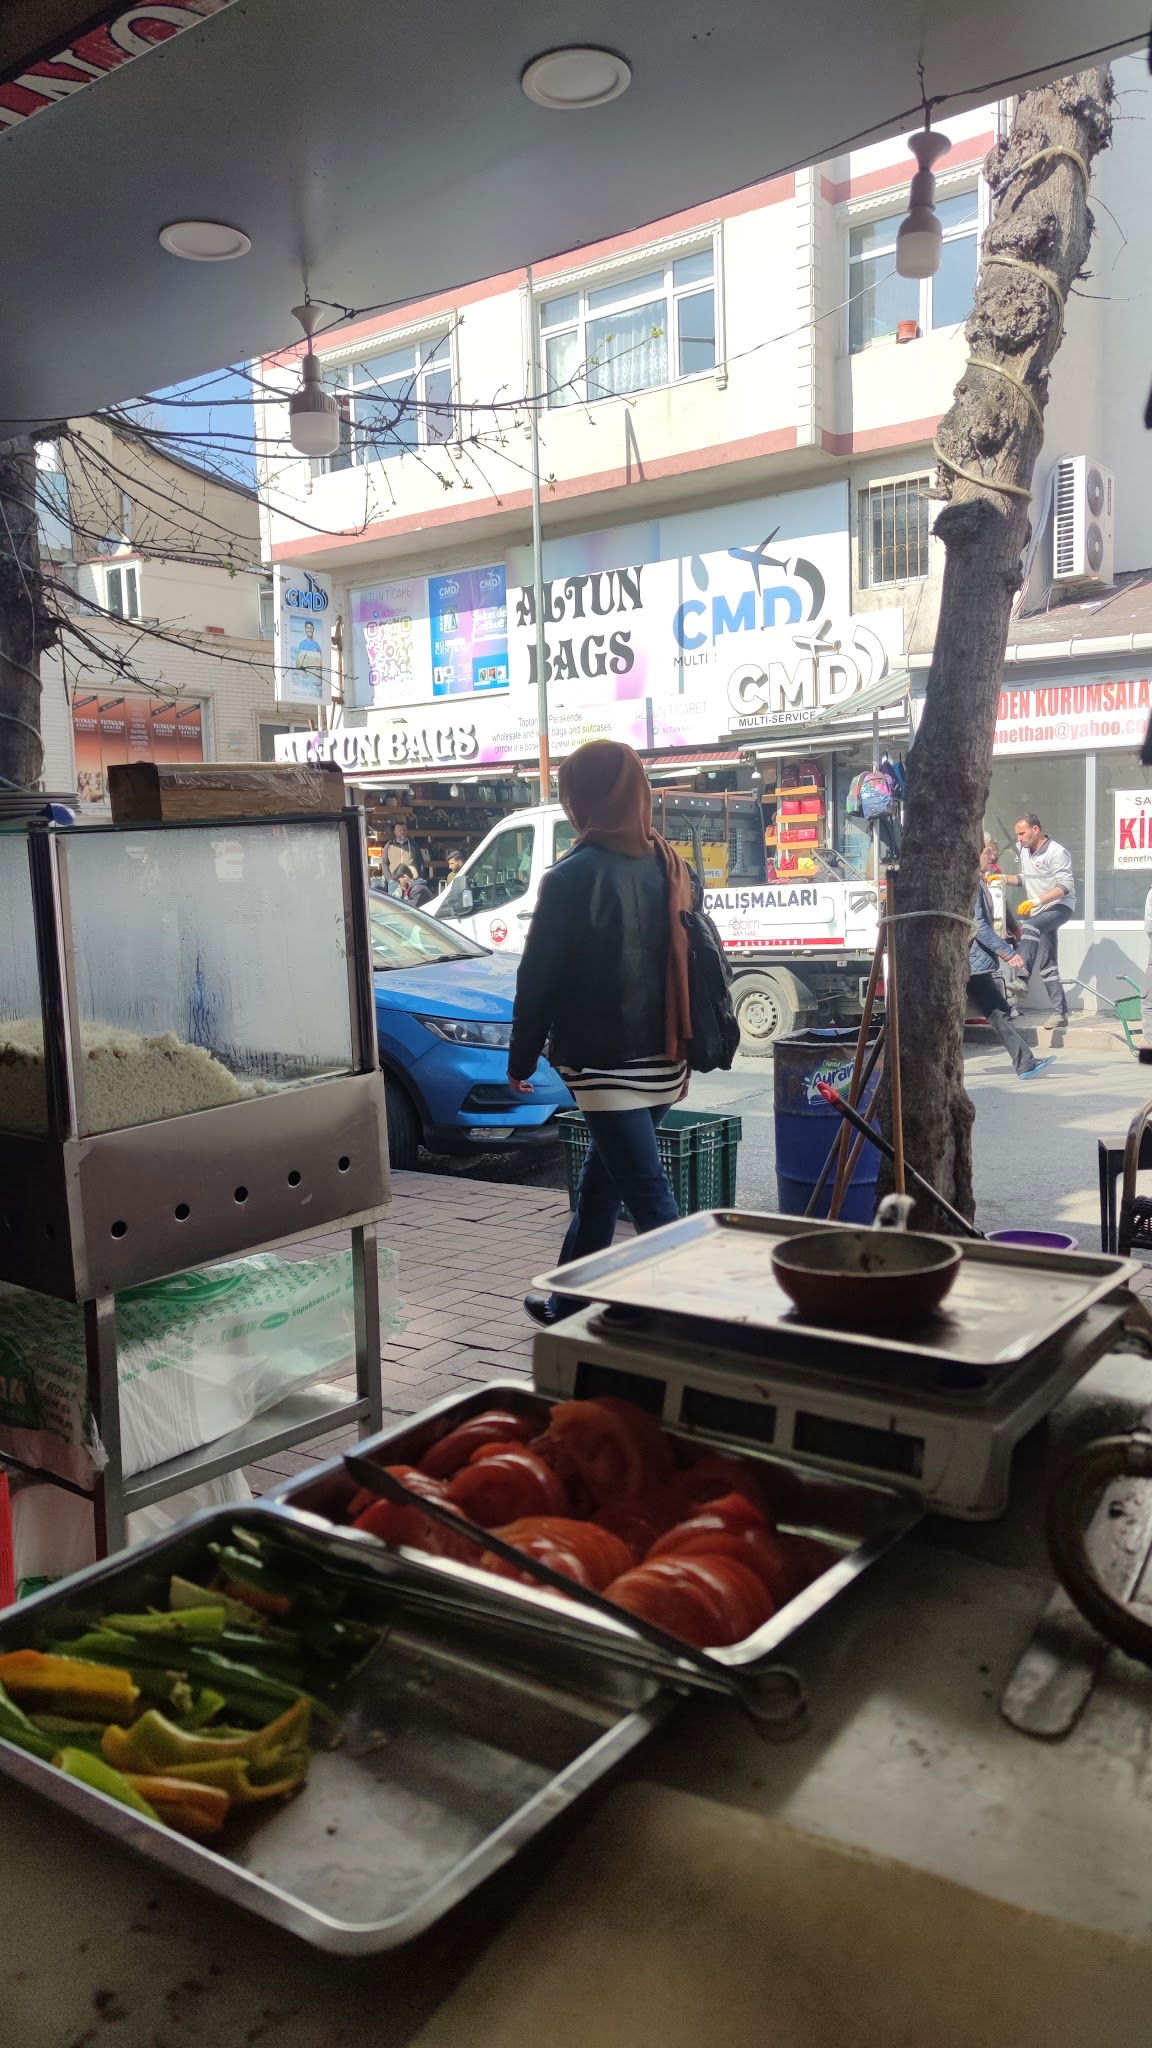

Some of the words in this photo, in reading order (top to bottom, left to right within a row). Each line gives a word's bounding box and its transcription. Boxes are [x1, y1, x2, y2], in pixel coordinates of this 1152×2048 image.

[286, 588, 325, 611] CMD
[516, 566, 643, 627] ALTUN
[673, 585, 803, 650] CMD
[527, 630, 635, 684] BAGS
[673, 653, 708, 668] MULTI
[727, 654, 859, 716] CMD
[1035, 679, 1150, 718] KURUMSALA
[492, 731, 521, 742] wholesale
[551, 726, 566, 737] bags
[569, 725, 580, 735] and
[582, 722, 612, 734] suitcases
[549, 712, 583, 724] Perakende
[738, 711, 816, 727] MULTI-SERVICE
[703, 888, 817, 916] ÇALIŞMALARI
